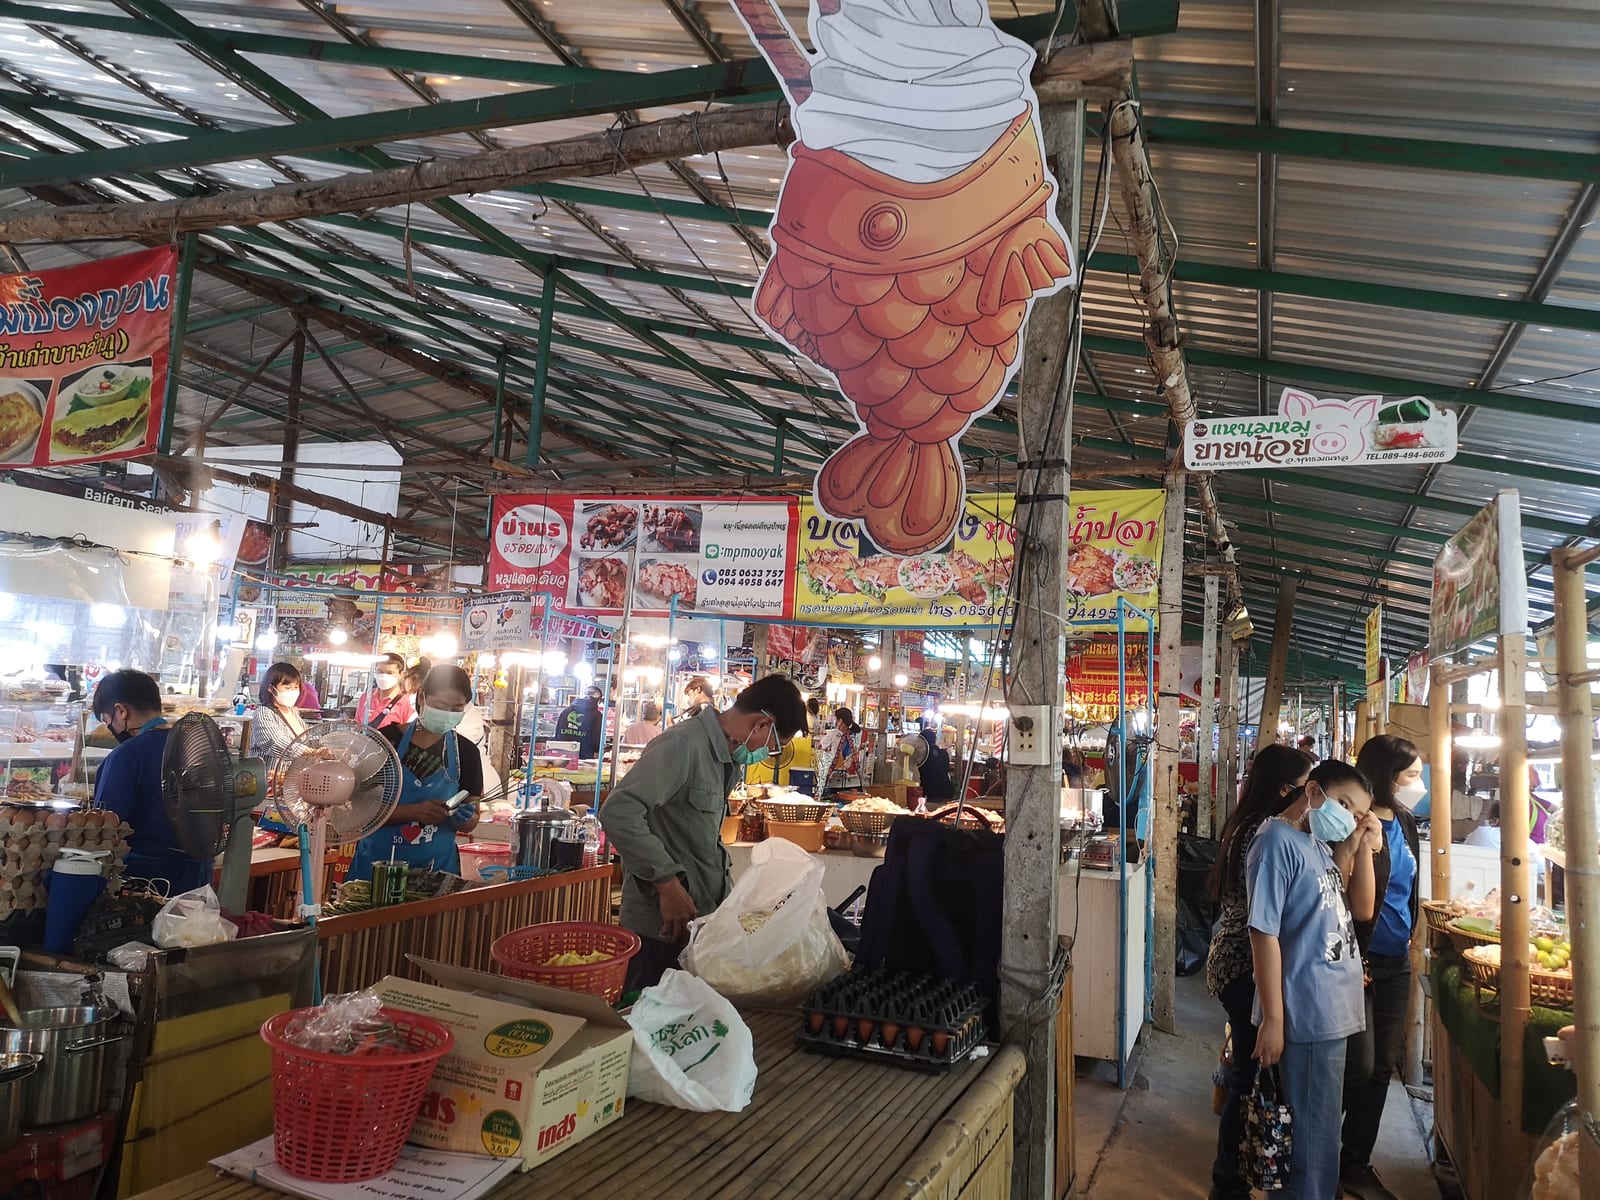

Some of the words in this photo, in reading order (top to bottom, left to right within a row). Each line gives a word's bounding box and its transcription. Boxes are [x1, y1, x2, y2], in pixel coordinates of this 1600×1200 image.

[1211, 419, 1311, 441] แหนมหมู
[1195, 435, 1311, 465] ยายน้อย
[1365, 450, 1446, 461] TEL.089-494-6006
[84, 488, 135, 509] Baifern
[502, 511, 561, 537] ป้าพร
[495, 570, 566, 589] หมูแดดเดียว
[718, 569, 737, 577] 085
[739, 569, 763, 577] 0633
[765, 569, 785, 578] 757
[718, 578, 736, 586] 094
[738, 578, 762, 586] 4958
[765, 578, 784, 587] 647
[423, 827, 433, 835] 50
[393, 835, 403, 844] 50
